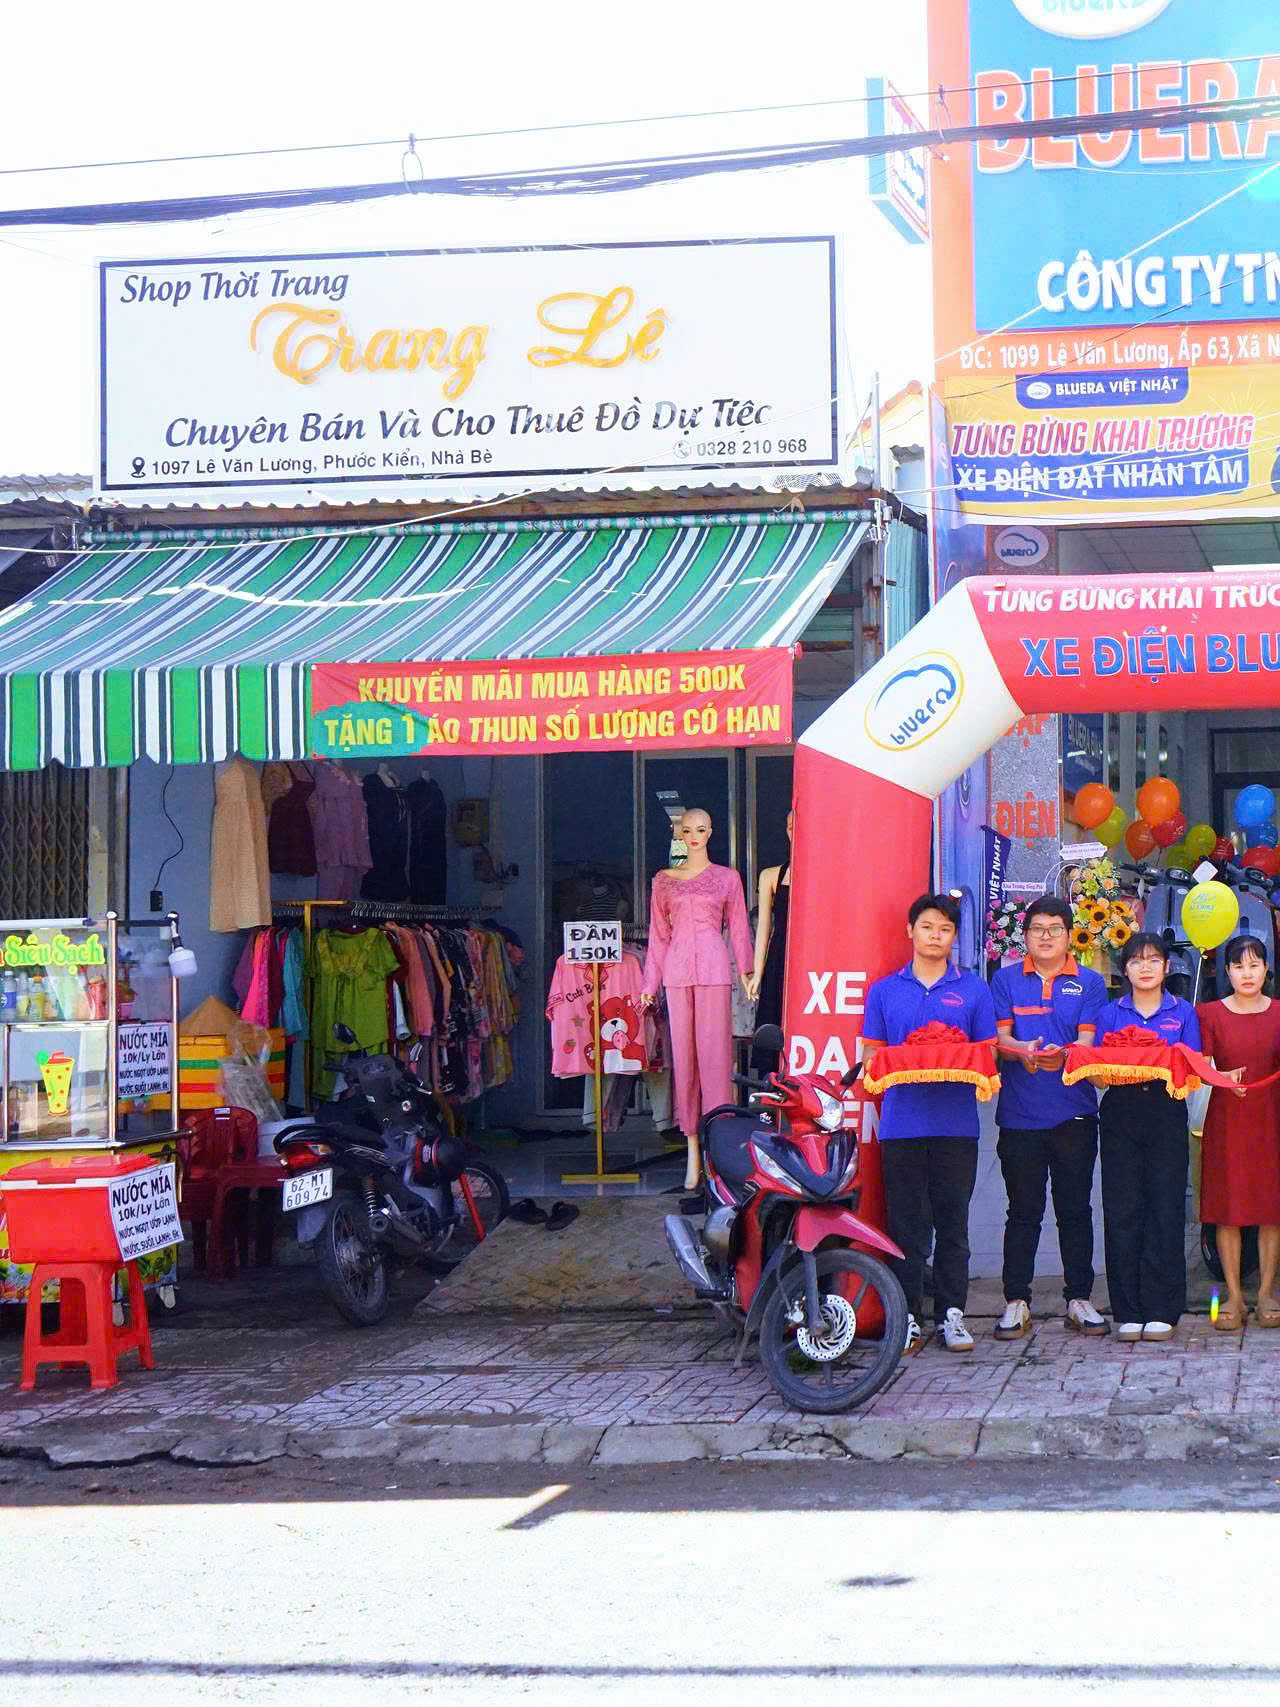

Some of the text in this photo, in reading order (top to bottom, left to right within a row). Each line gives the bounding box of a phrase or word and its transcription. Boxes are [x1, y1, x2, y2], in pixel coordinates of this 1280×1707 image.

[120, 269, 349, 307] Shop Thời Trang
[1037, 250, 1165, 312] CÔNG
[1171, 254, 1230, 306] TY
[249, 286, 668, 402] Trang Lê
[960, 350, 992, 369] ĐC:
[1000, 345, 1039, 369] 1099
[1047, 342, 1068, 367] Lê
[1075, 340, 1106, 366] Văn
[1114, 340, 1174, 368] Lương,
[1178, 327, 1201, 365] Ấp
[1208, 335, 1232, 364] 63,
[1237, 334, 1260, 359] Xã
[1056, 377, 1178, 396] BLUERA VIỆT NHẬT
[165, 397, 771, 452] Chuyên Bán Và Cho Thuê Đồ Dự Tiệc
[952, 414, 1256, 457] TƯNG BỪNG KHAI TRƯƠNG
[152, 447, 492, 475] 1097 Lê Văn Lương, Phước Kiển, Nhà Bè
[697, 438, 807, 456] 0328 210 968
[957, 455, 1243, 497] XE ĐIỆN ĐẠT NHÂN TÂM
[1140, 586, 1203, 608] KHAI
[1020, 638, 1080, 677] XE
[1093, 625, 1198, 683] ĐIỆN
[358, 664, 745, 704] KHUYẾN MÃI MUA HÀNG 500K
[324, 703, 781, 752] TẶNG 1 ÁO THUN SỐ LƯỢNG CÓ HẠN
[569, 923, 617, 941] ĐẦM
[51, 933, 106, 975] Sạch
[568, 946, 618, 961] 150k
[804, 971, 866, 1015] XE
[120, 1026, 168, 1050] NƯỚC MÍA
[123, 1052, 150, 1063] 10k/Ly
[113, 1170, 172, 1208] NƯỚC MÍA
[286, 1185, 328, 1208] 609.74
[118, 1197, 170, 1222] 10k/Ly Lớn
